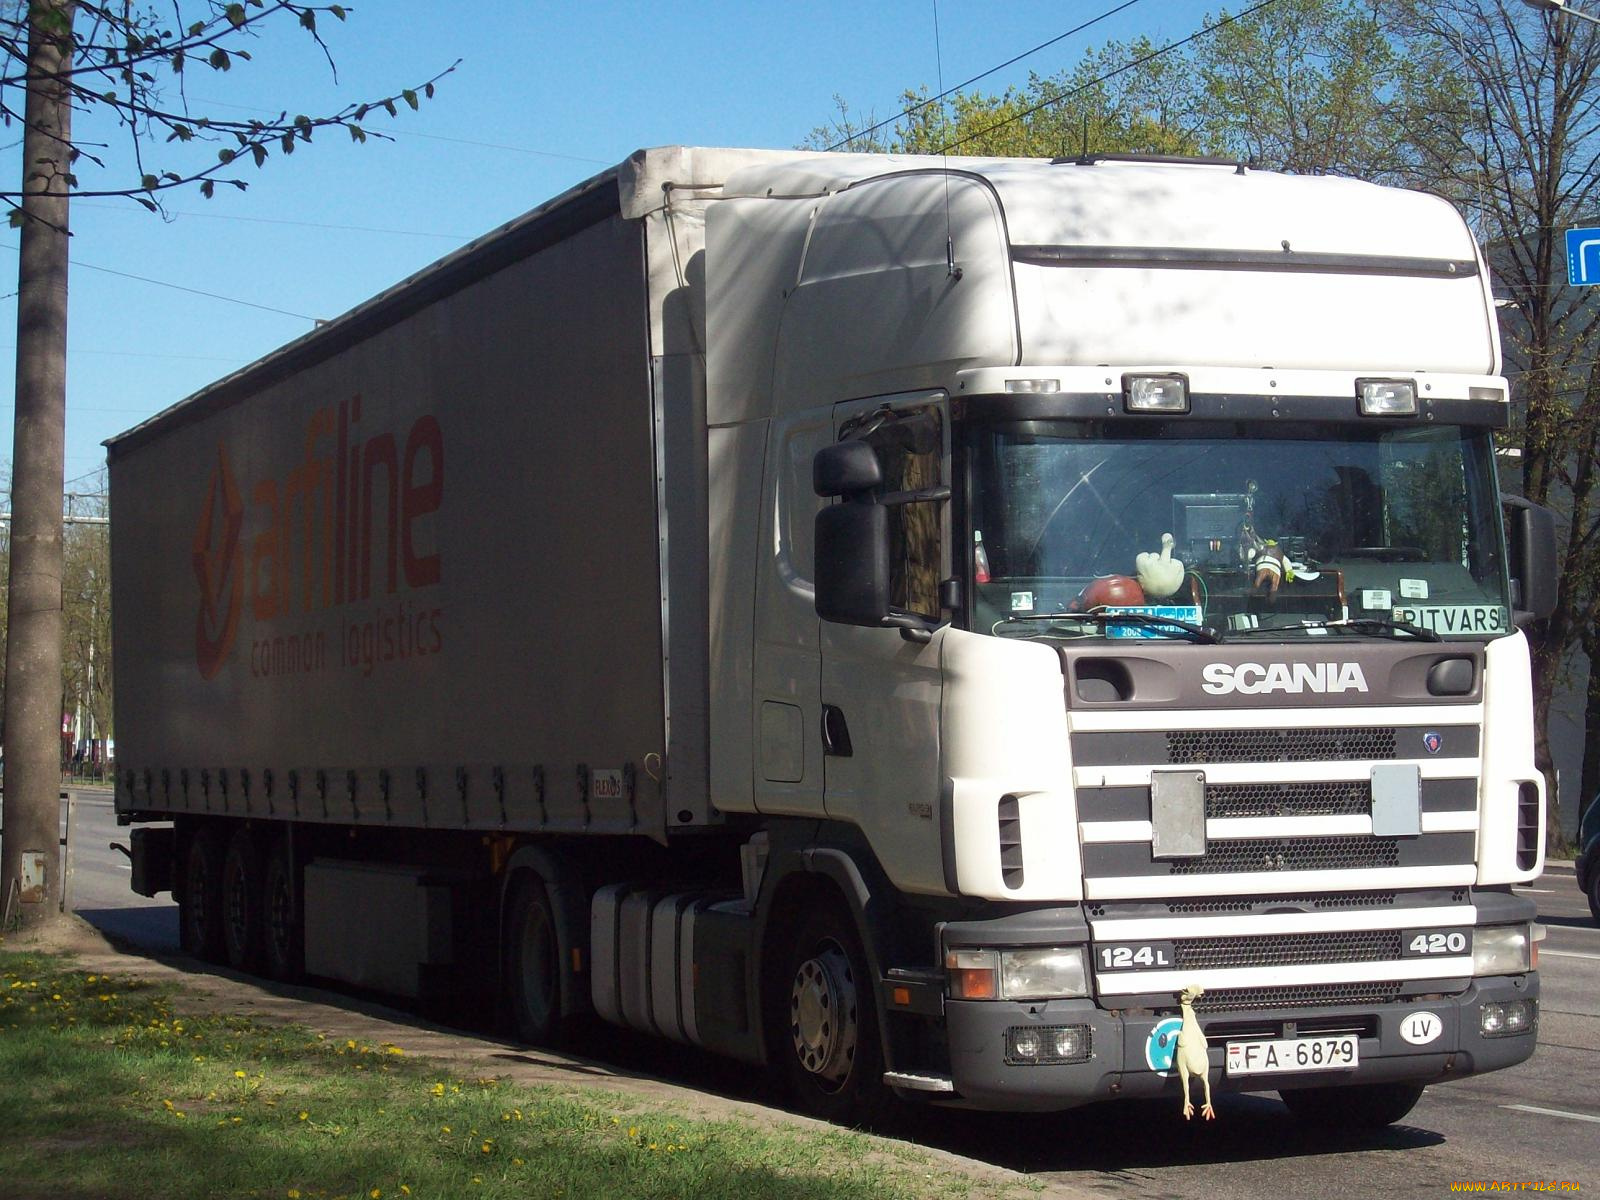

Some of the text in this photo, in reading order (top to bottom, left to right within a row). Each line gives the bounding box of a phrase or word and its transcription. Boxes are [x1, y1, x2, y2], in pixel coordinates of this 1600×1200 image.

[251, 601, 444, 678] common logistics
[1201, 662, 1369, 695] SCANIA
[1409, 932, 1466, 953] 420
[1412, 1019, 1431, 1038] LV
[1229, 1061, 1240, 1070] LV
